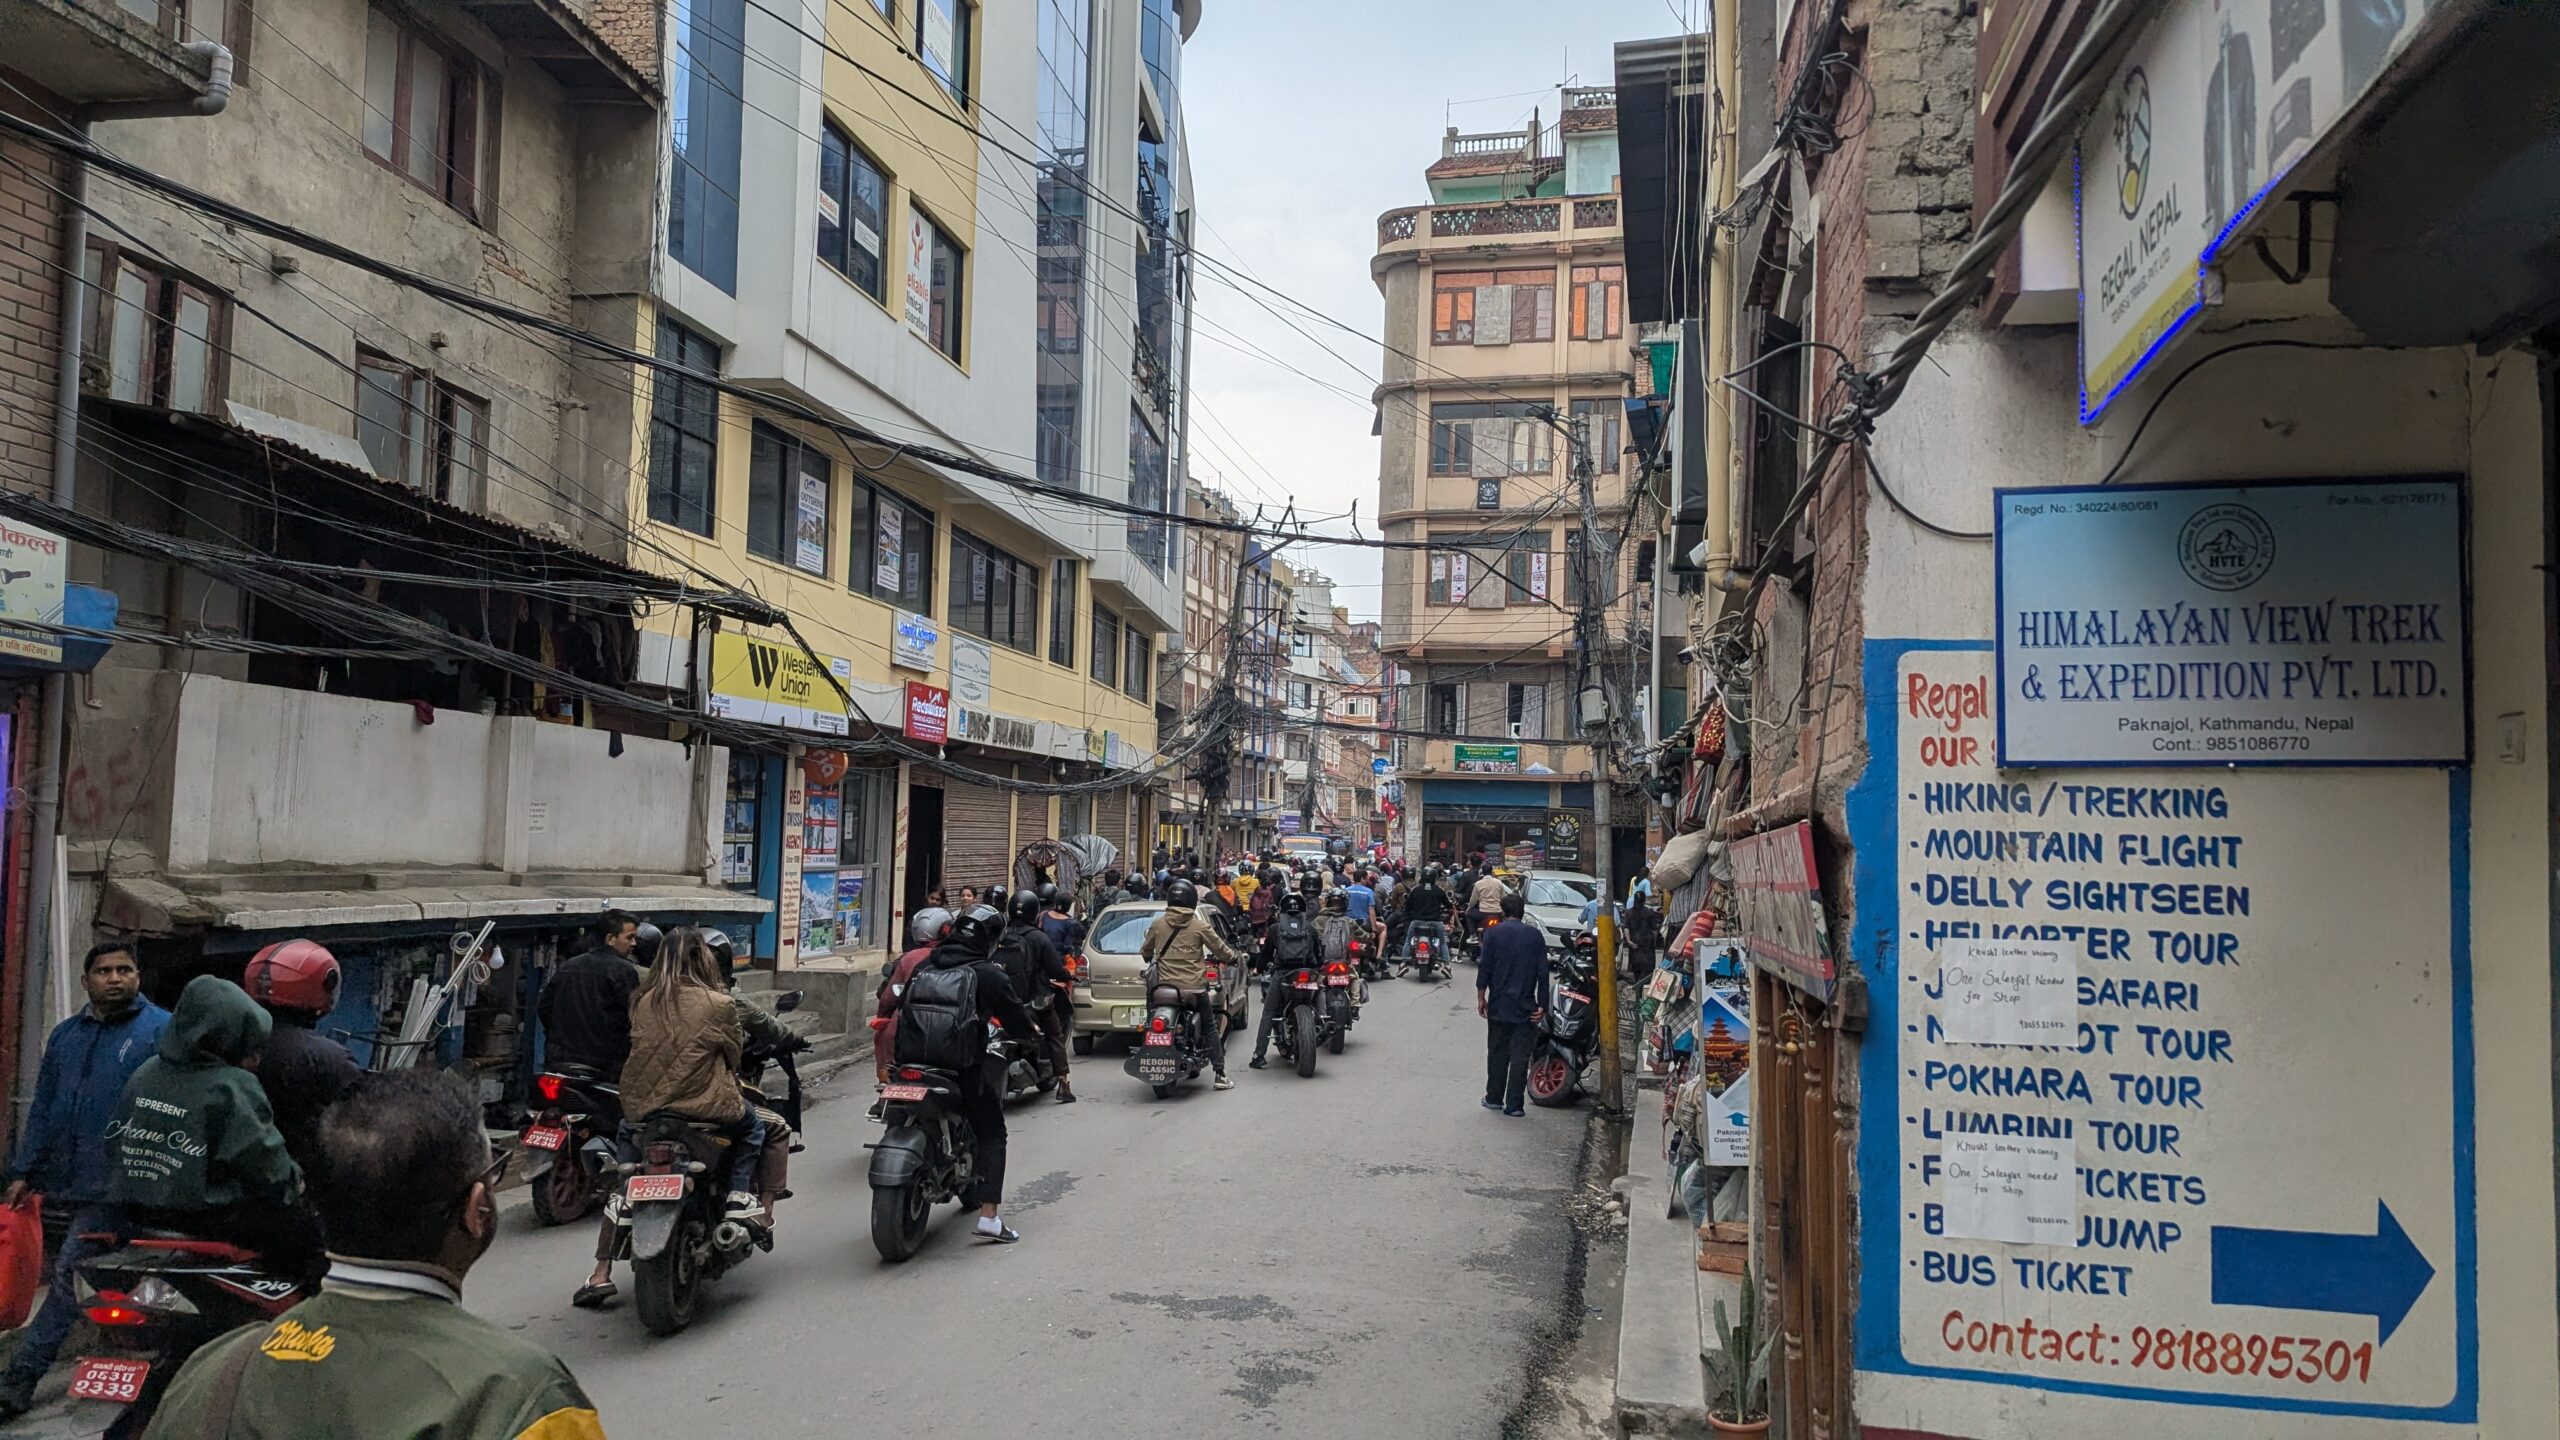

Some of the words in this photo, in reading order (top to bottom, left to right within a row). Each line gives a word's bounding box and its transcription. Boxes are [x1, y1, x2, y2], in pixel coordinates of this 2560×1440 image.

[2101, 241, 2137, 312] REGAL
[2140, 182, 2181, 263] NEPAL
[906, 290, 923, 314] linical
[907, 272, 928, 302] eliable
[905, 308, 928, 337] aboratory
[2210, 555, 2246, 568] HVTE
[2018, 602, 2230, 649] HIMALAYAN
[2242, 597, 2335, 645] VIEW
[2343, 604, 2445, 645] TREK
[780, 672, 811, 697] Union
[2021, 664, 2046, 700] &
[2058, 661, 2270, 702] EXPEDITION
[2283, 655, 2359, 700] PVT.
[2372, 660, 2447, 699] LTD.
[1908, 673, 1989, 733] Regal
[2118, 716, 2194, 733] Paknajol,
[2199, 717, 2299, 733] Kathmandu,
[2305, 716, 2354, 734] Nepal
[1921, 736, 1981, 767] OUR
[2152, 737, 2201, 751] Cont.:
[2206, 737, 2310, 751] 9851086770
[789, 789, 801, 805] RED
[1550, 814, 1580, 829] TATTOO
[1924, 828, 2103, 864] MOUNTAIN
[2118, 834, 2243, 868] FLIGHT
[1926, 873, 2033, 908] DELLY
[2046, 880, 2250, 917] SIGHTSEEN
[2149, 930, 2240, 966] TOUR
[1946, 967, 1974, 986] One
[1993, 991, 2020, 1005] Shop
[2077, 976, 2198, 1012] SAFARI
[2137, 1024, 2235, 1062] TOUR
[1140, 1058, 1176, 1066] REBORN
[1924, 1060, 2093, 1104] POKHARA
[2109, 1073, 2204, 1110] TOUR
[135, 1097, 187, 1118] REPRESENT
[2088, 1119, 2181, 1157] TOUR
[1949, 1162, 1971, 1179] One
[2076, 1214, 2182, 1253] JUMP
[250, 1280, 292, 1291] Dio
[1923, 1250, 1996, 1287] BUS
[2012, 1258, 2133, 1297] TICKET
[1942, 1310, 2121, 1366] Contact:
[2130, 1326, 2374, 1384] 9818895301
